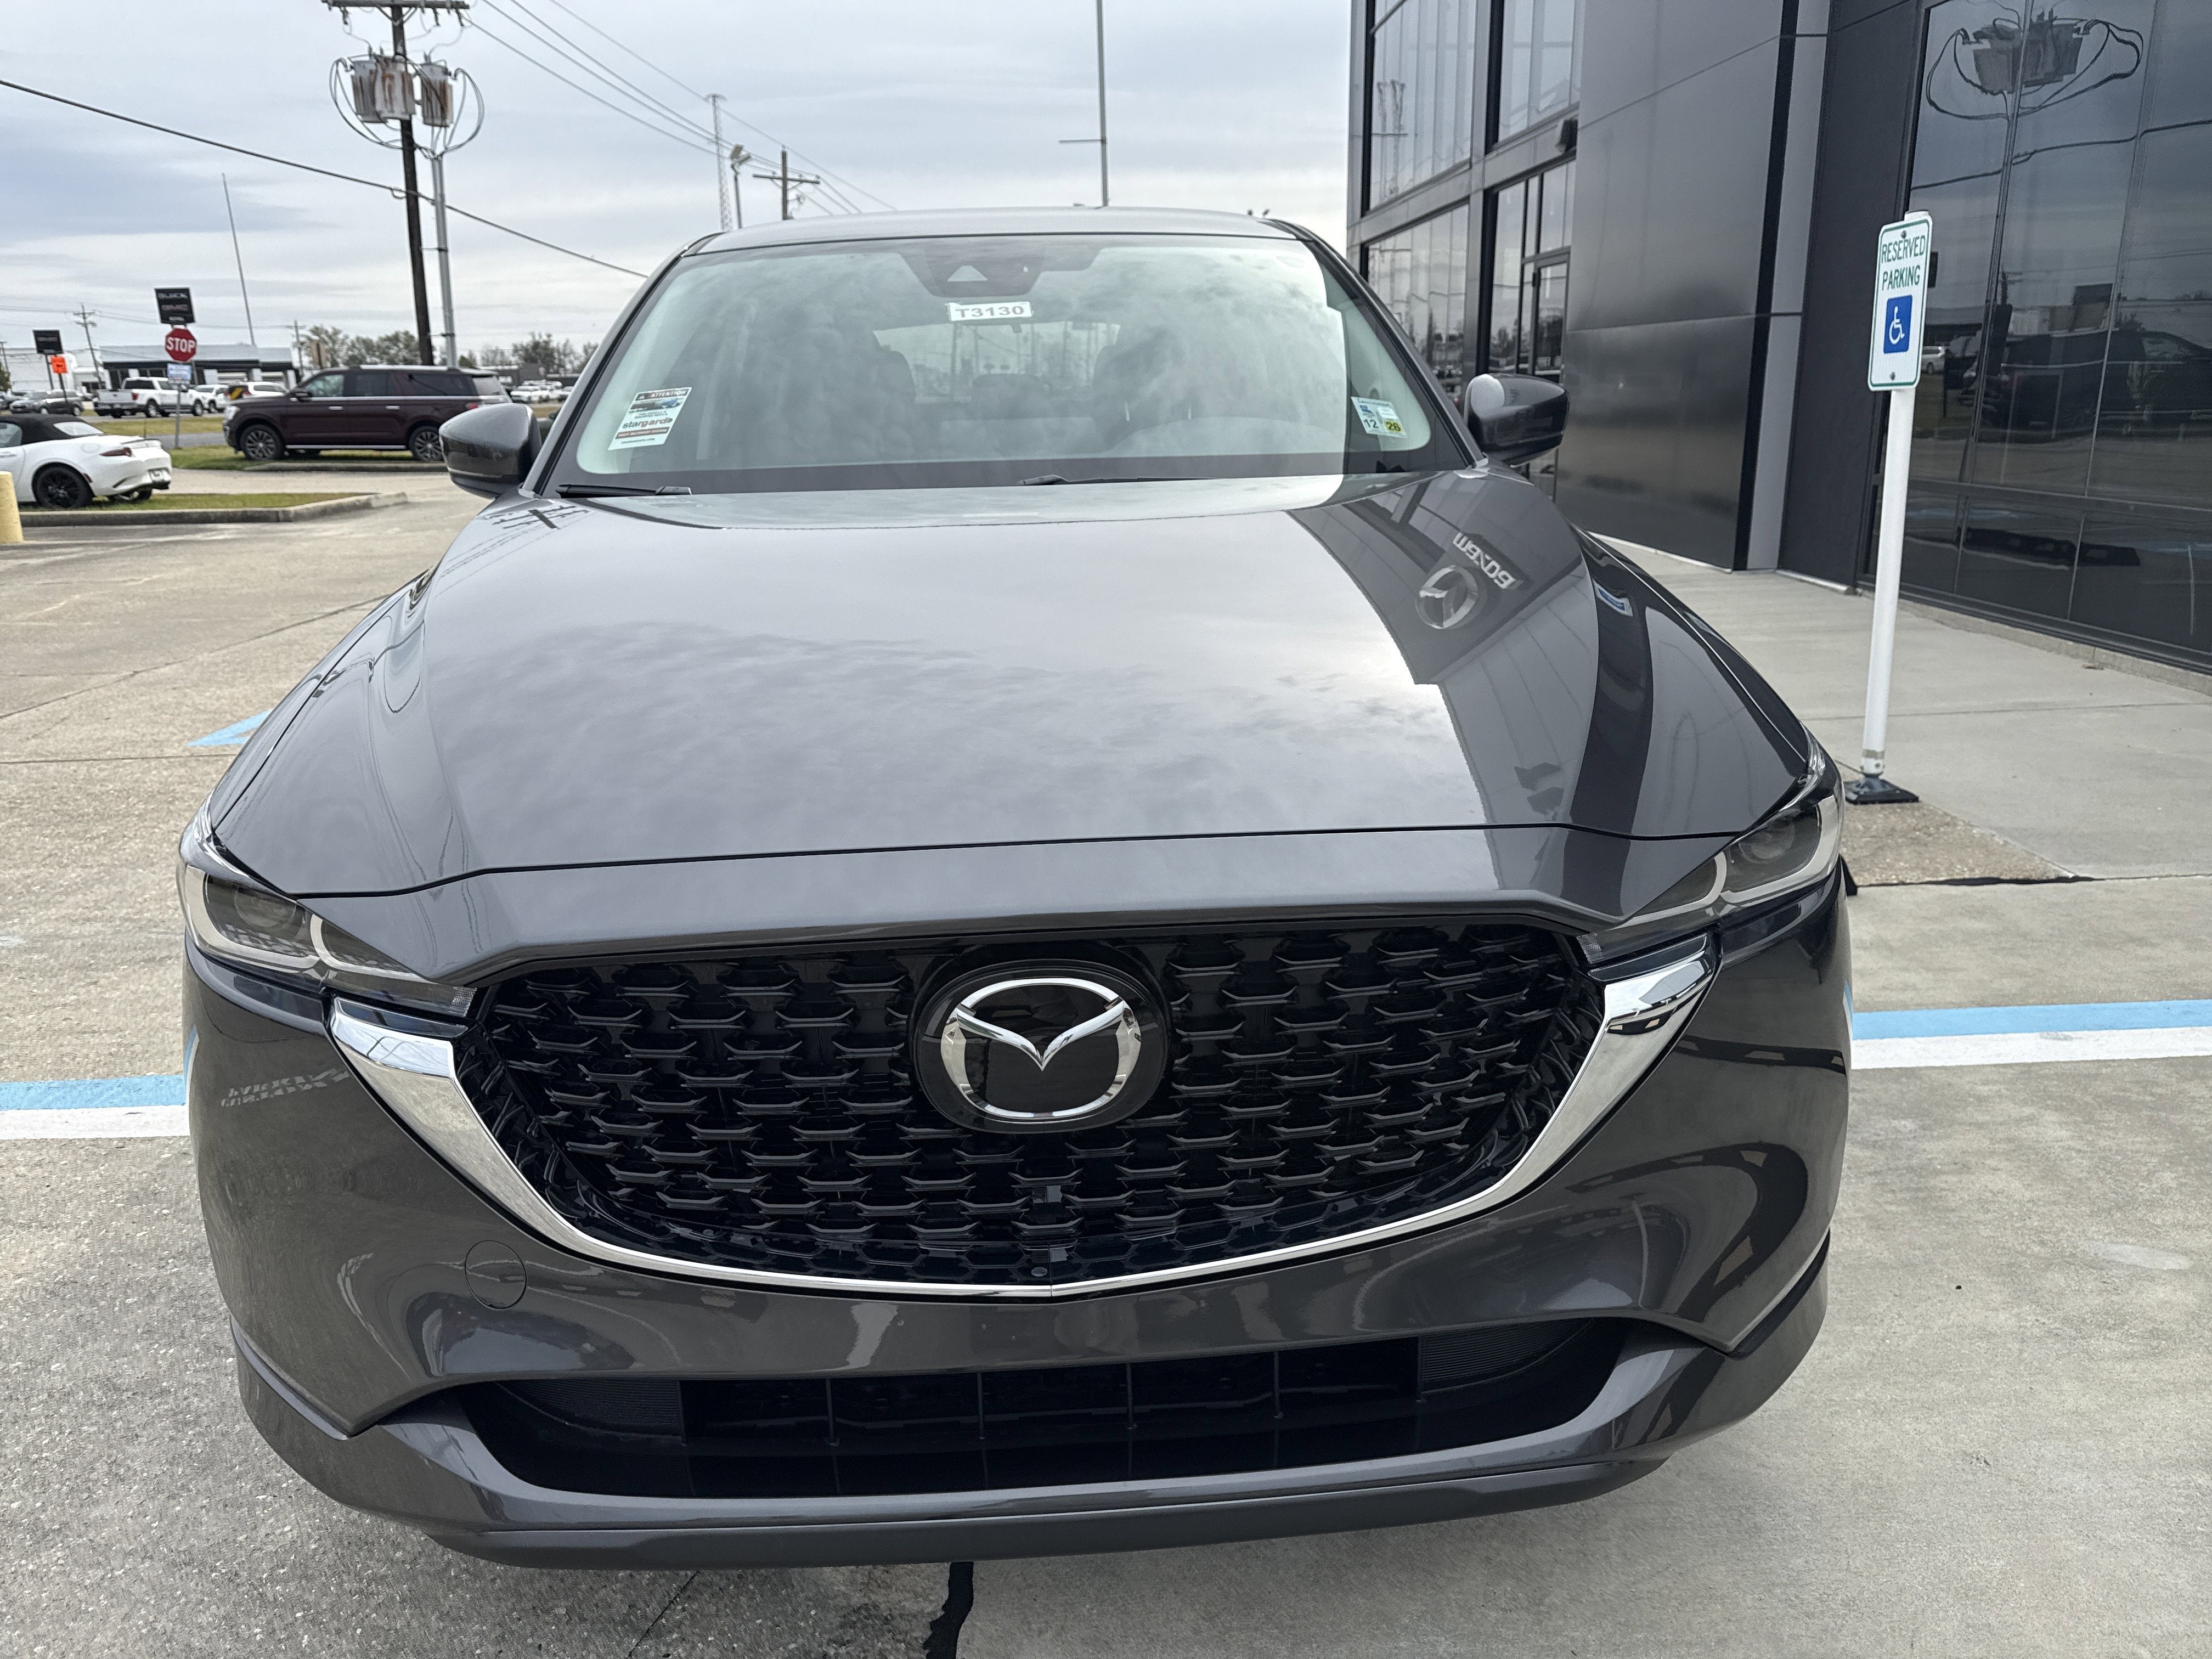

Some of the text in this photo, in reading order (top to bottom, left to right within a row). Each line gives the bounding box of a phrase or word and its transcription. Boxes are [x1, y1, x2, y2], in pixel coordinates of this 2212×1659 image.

[1882, 235, 1926, 263] RESERVED
[1882, 264, 1921, 291] PARKING
[955, 306, 1024, 318] T3130
[166, 336, 195, 353] STOP
[650, 390, 687, 398] ATTENTION
[1364, 419, 1379, 428] 12
[1386, 421, 1401, 432] 26
